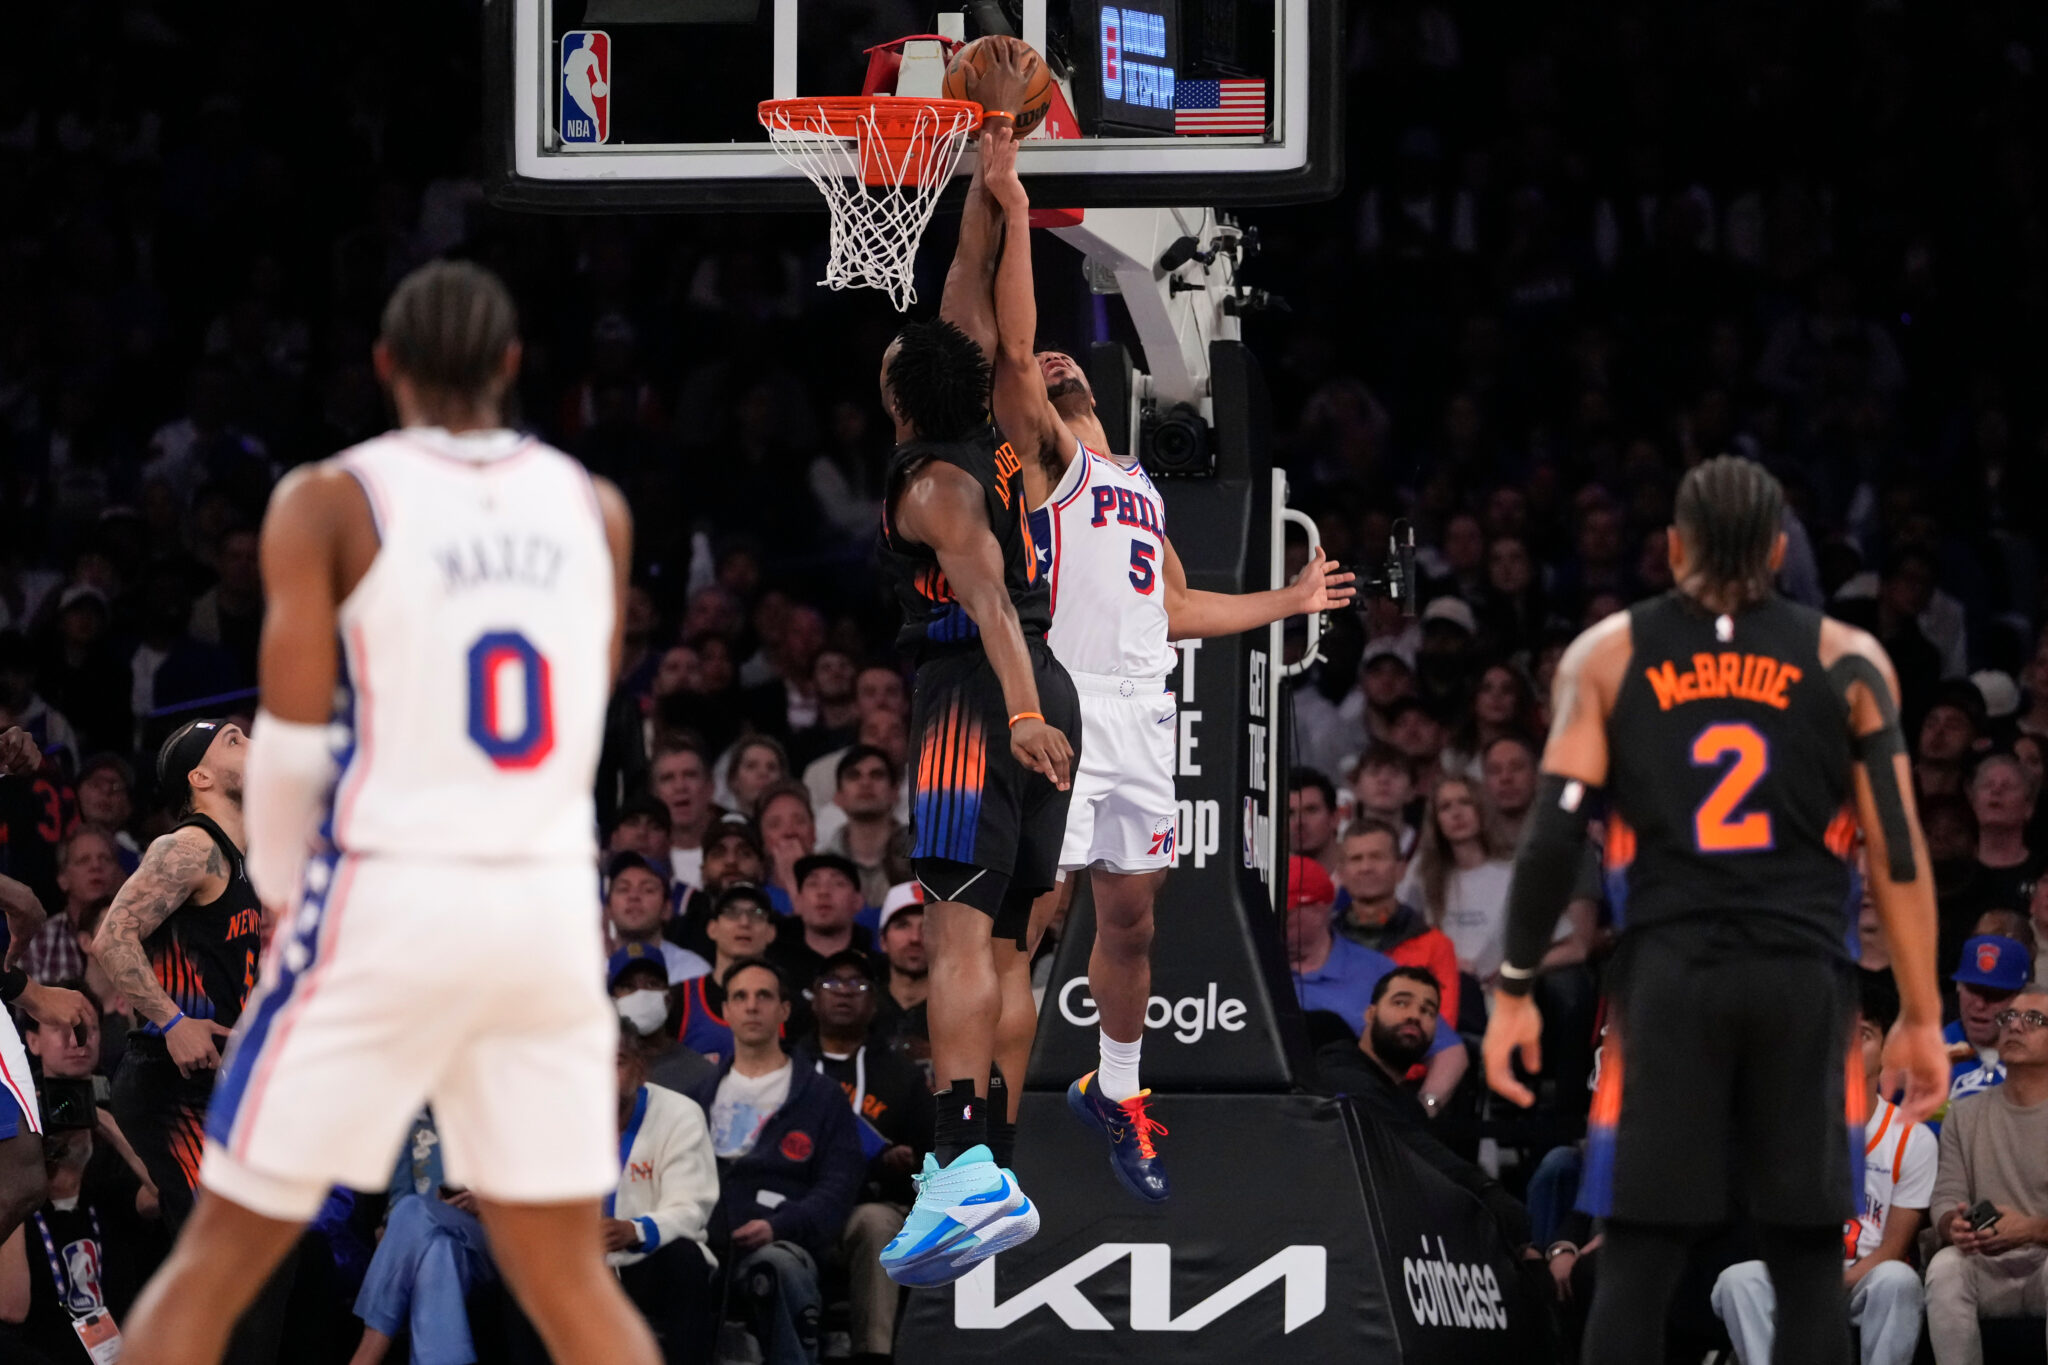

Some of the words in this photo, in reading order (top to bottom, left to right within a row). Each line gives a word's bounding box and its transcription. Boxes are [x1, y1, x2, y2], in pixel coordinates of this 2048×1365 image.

[1123, 60, 1139, 105] THE
[1139, 62, 1159, 108] ESPN
[567, 119, 590, 138] NBA
[1091, 484, 1166, 547] PHIL
[1129, 538, 1156, 597] 5
[465, 627, 556, 773] 0
[1248, 648, 1267, 719] GET
[1645, 652, 1803, 711] McBRIDE
[1248, 722, 1267, 791] THE
[1691, 720, 1775, 853] 2
[1146, 826, 1174, 855] 76
[1169, 799, 1221, 869] pp
[1058, 976, 1248, 1044] Gogle
[955, 1243, 1327, 1334] KIA
[1403, 1233, 1508, 1331] coinbase
